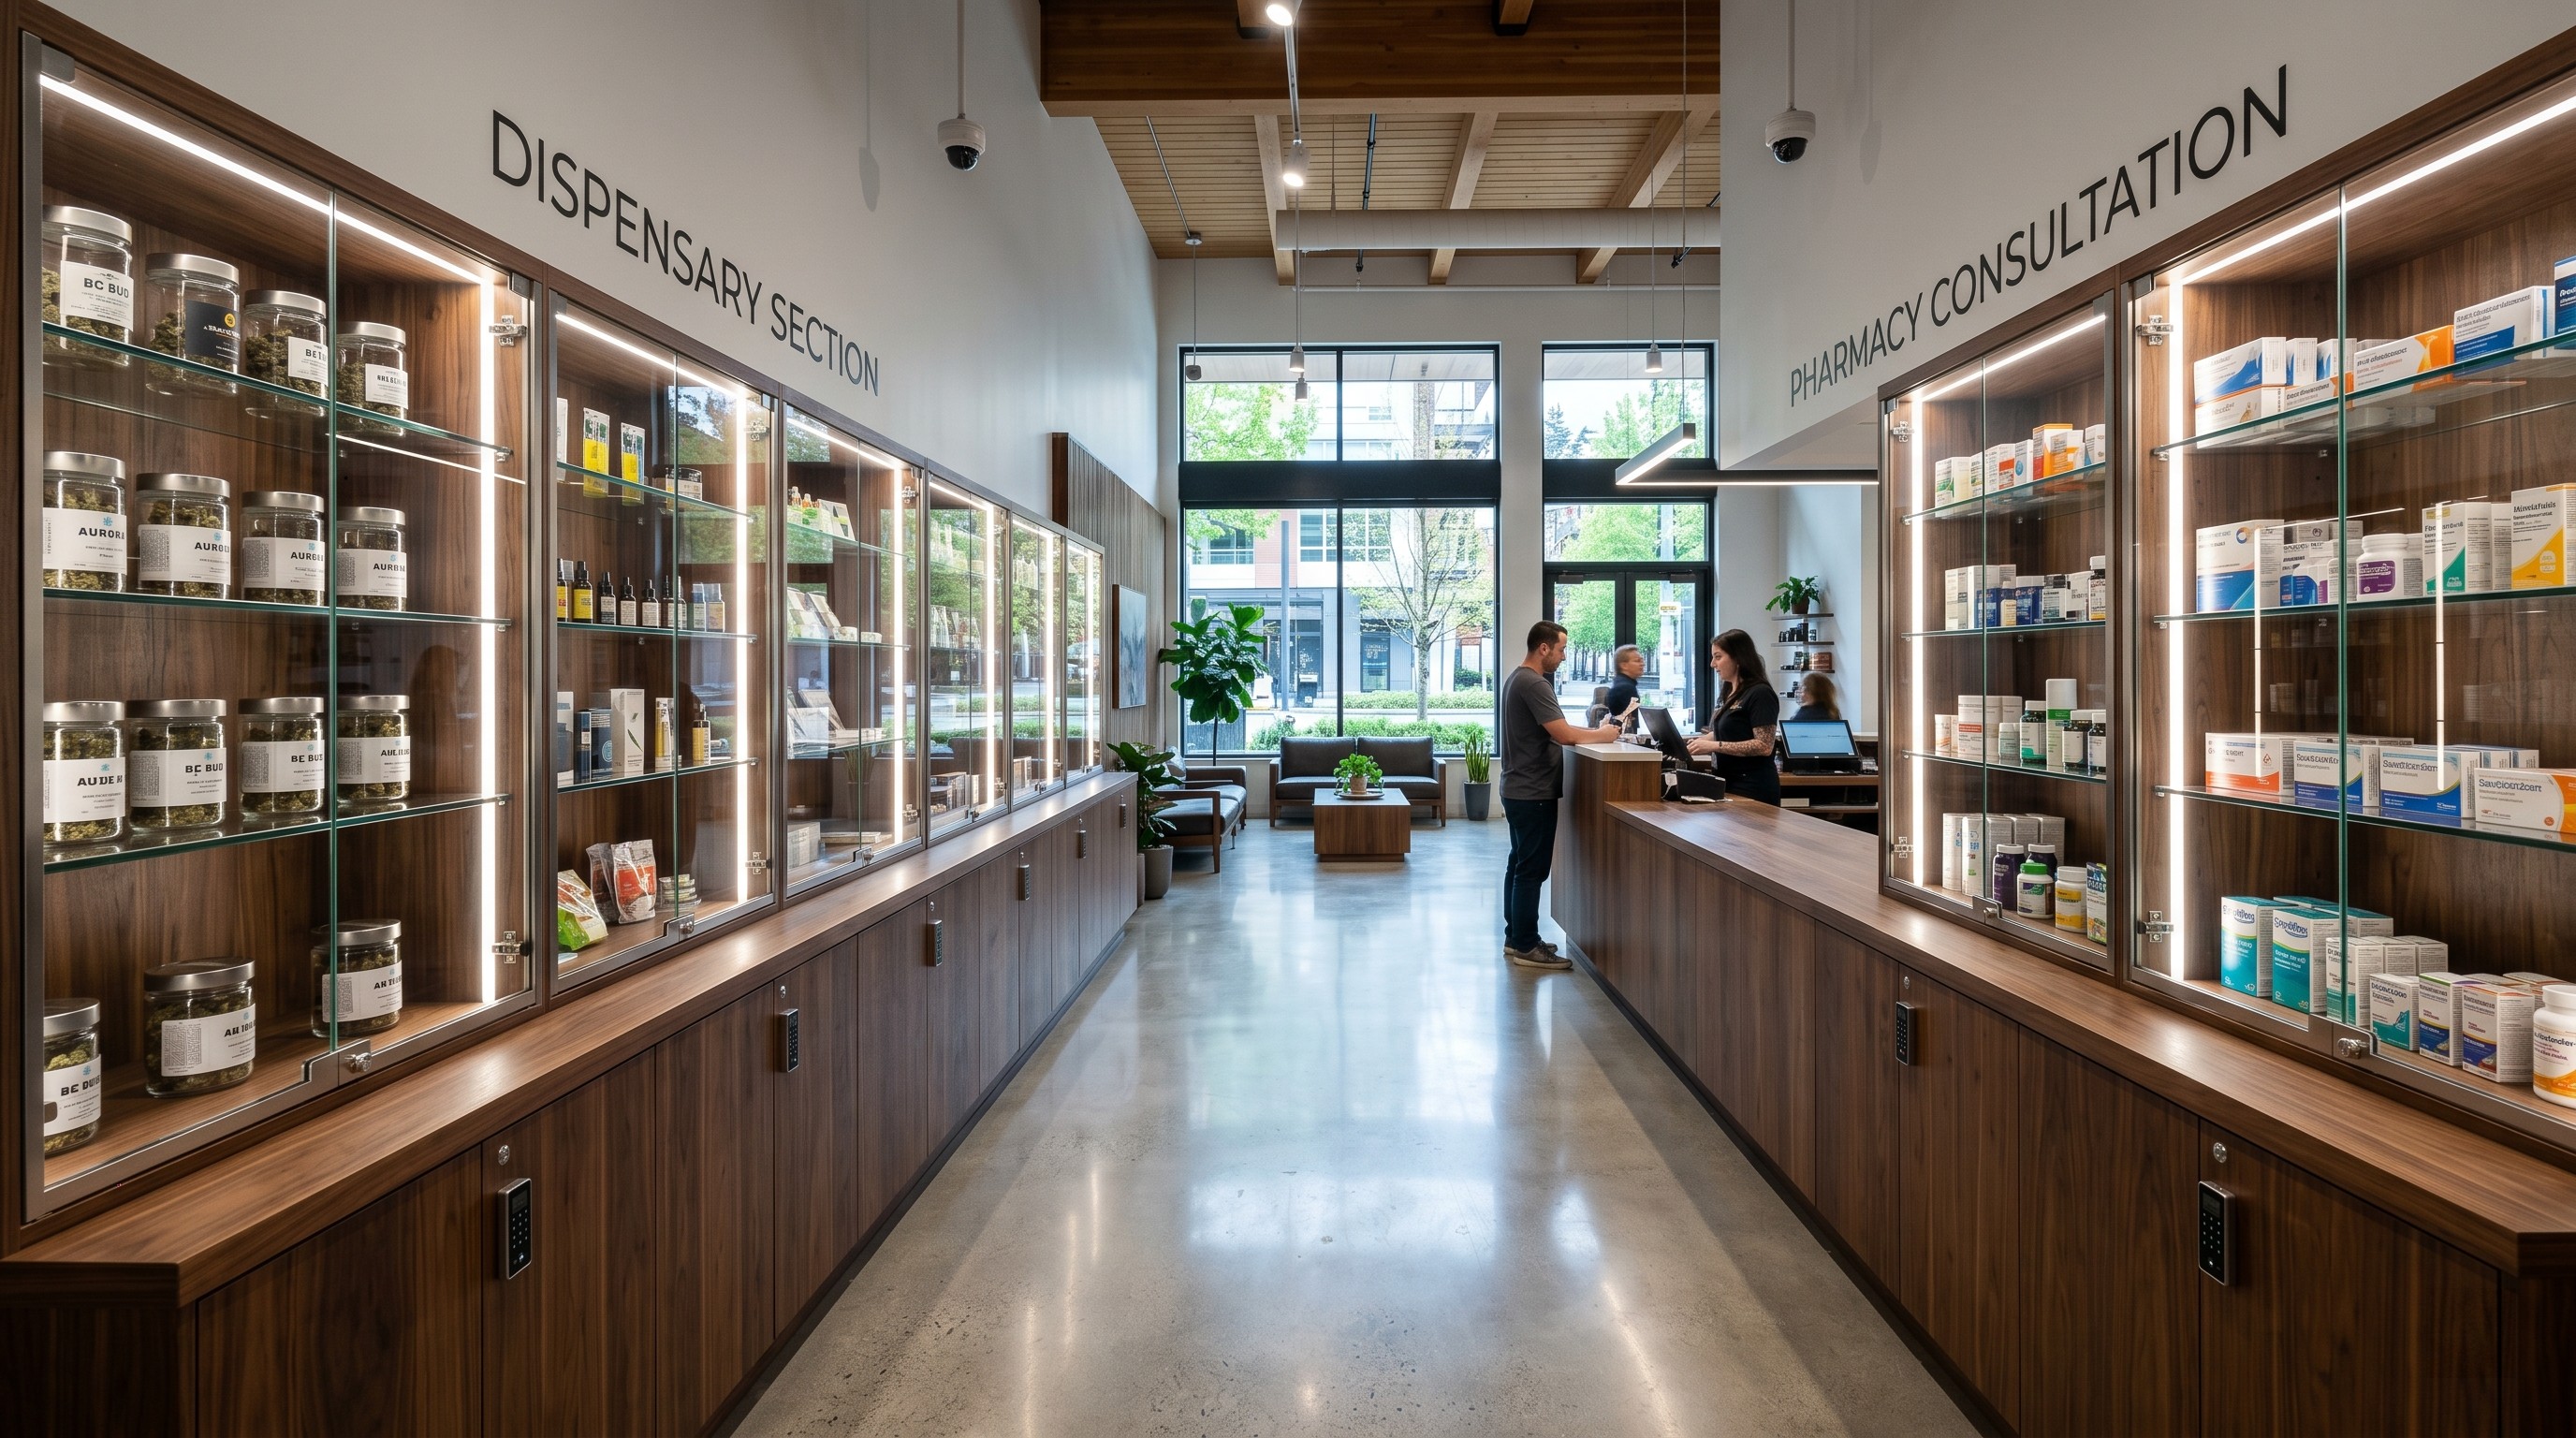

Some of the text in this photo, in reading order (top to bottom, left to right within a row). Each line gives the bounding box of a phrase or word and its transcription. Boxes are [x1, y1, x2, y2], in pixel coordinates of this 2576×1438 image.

[83, 277, 104, 290] BC
[492, 109, 879, 397] DISPENSARY SECTION
[1790, 64, 2287, 408] PHARMACY CONSULTATION
